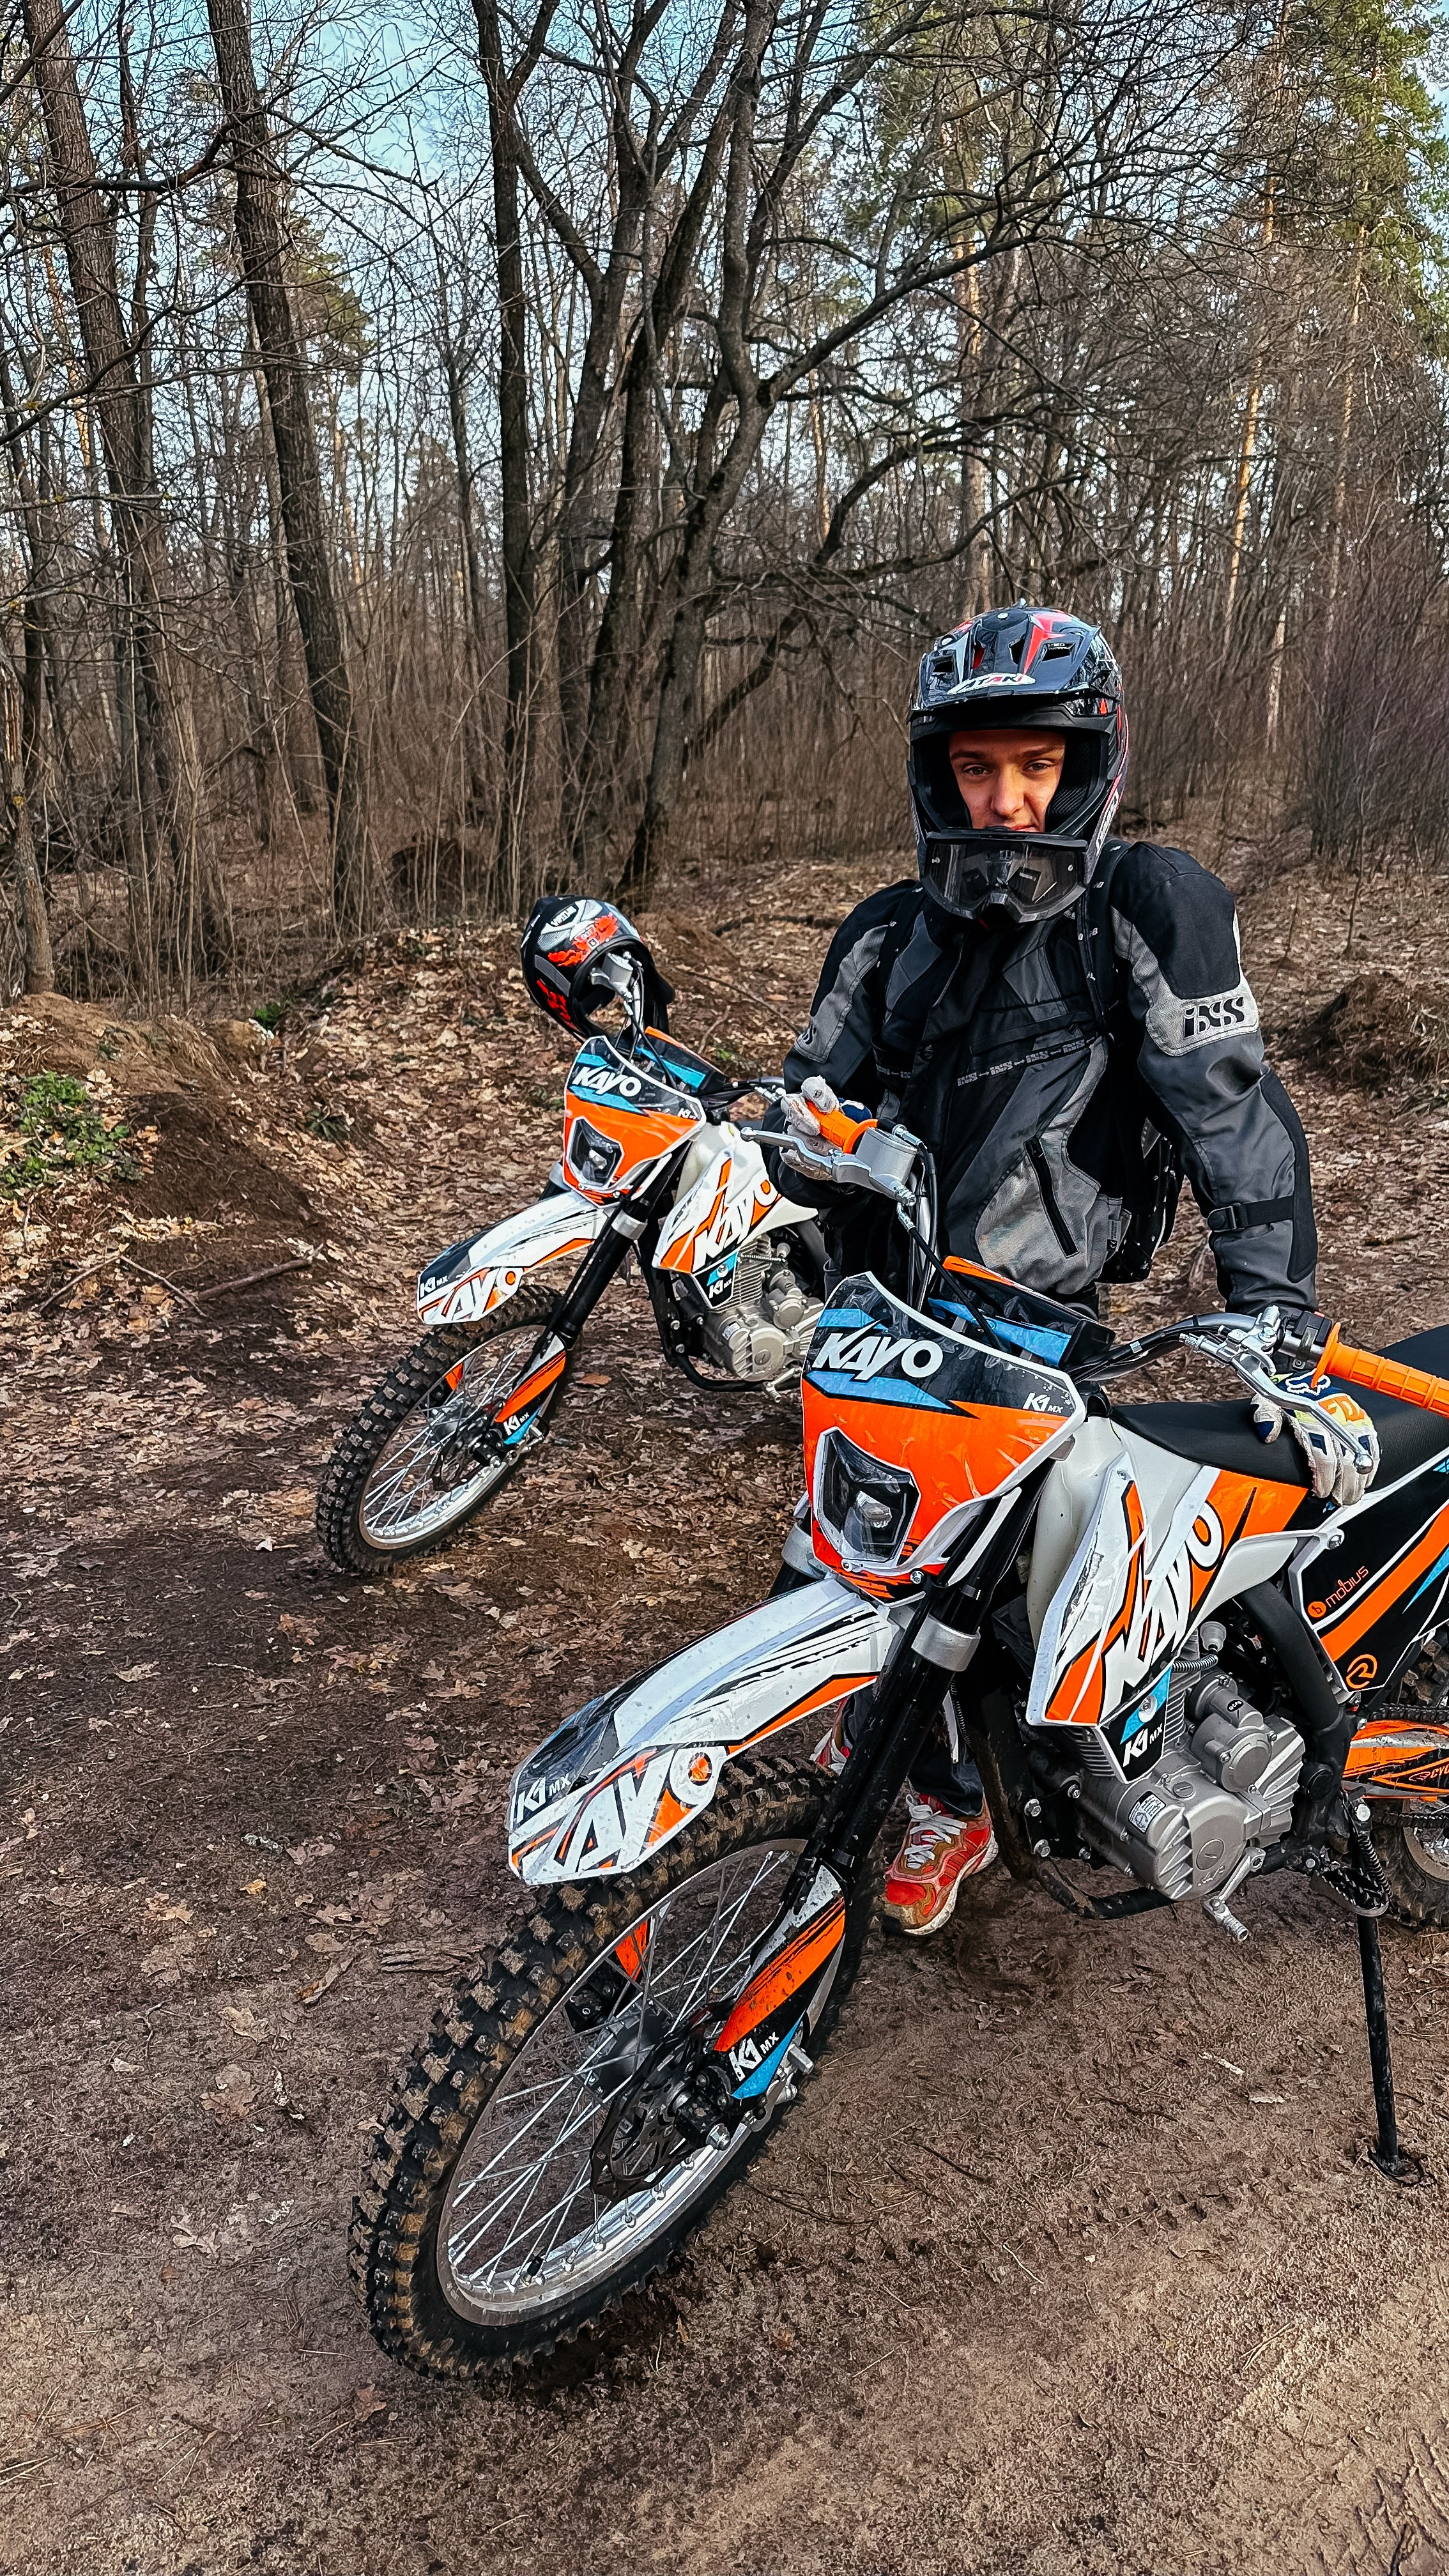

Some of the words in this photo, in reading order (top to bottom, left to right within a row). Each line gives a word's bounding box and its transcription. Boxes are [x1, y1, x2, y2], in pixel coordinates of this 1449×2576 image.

[572, 1064, 641, 1097] KAYO
[692, 1173, 779, 1272] KAYO
[420, 1276, 436, 1298] K1
[437, 1275, 448, 1287] MX
[709, 1280, 724, 1299] K1
[811, 1319, 944, 1381] KAYO
[503, 1414, 521, 1436] K1
[519, 1412, 530, 1424] MX
[1022, 1392, 1051, 1412] K1
[1046, 1404, 1064, 1414] MX
[1100, 1499, 1225, 1723] KAYO
[1123, 1728, 1148, 1768] K1
[1149, 1722, 1163, 1745] MX
[516, 1777, 547, 1824] K1
[548, 1772, 572, 1797] MX
[728, 2037, 763, 2082] K1
[760, 2031, 779, 2055] MX
